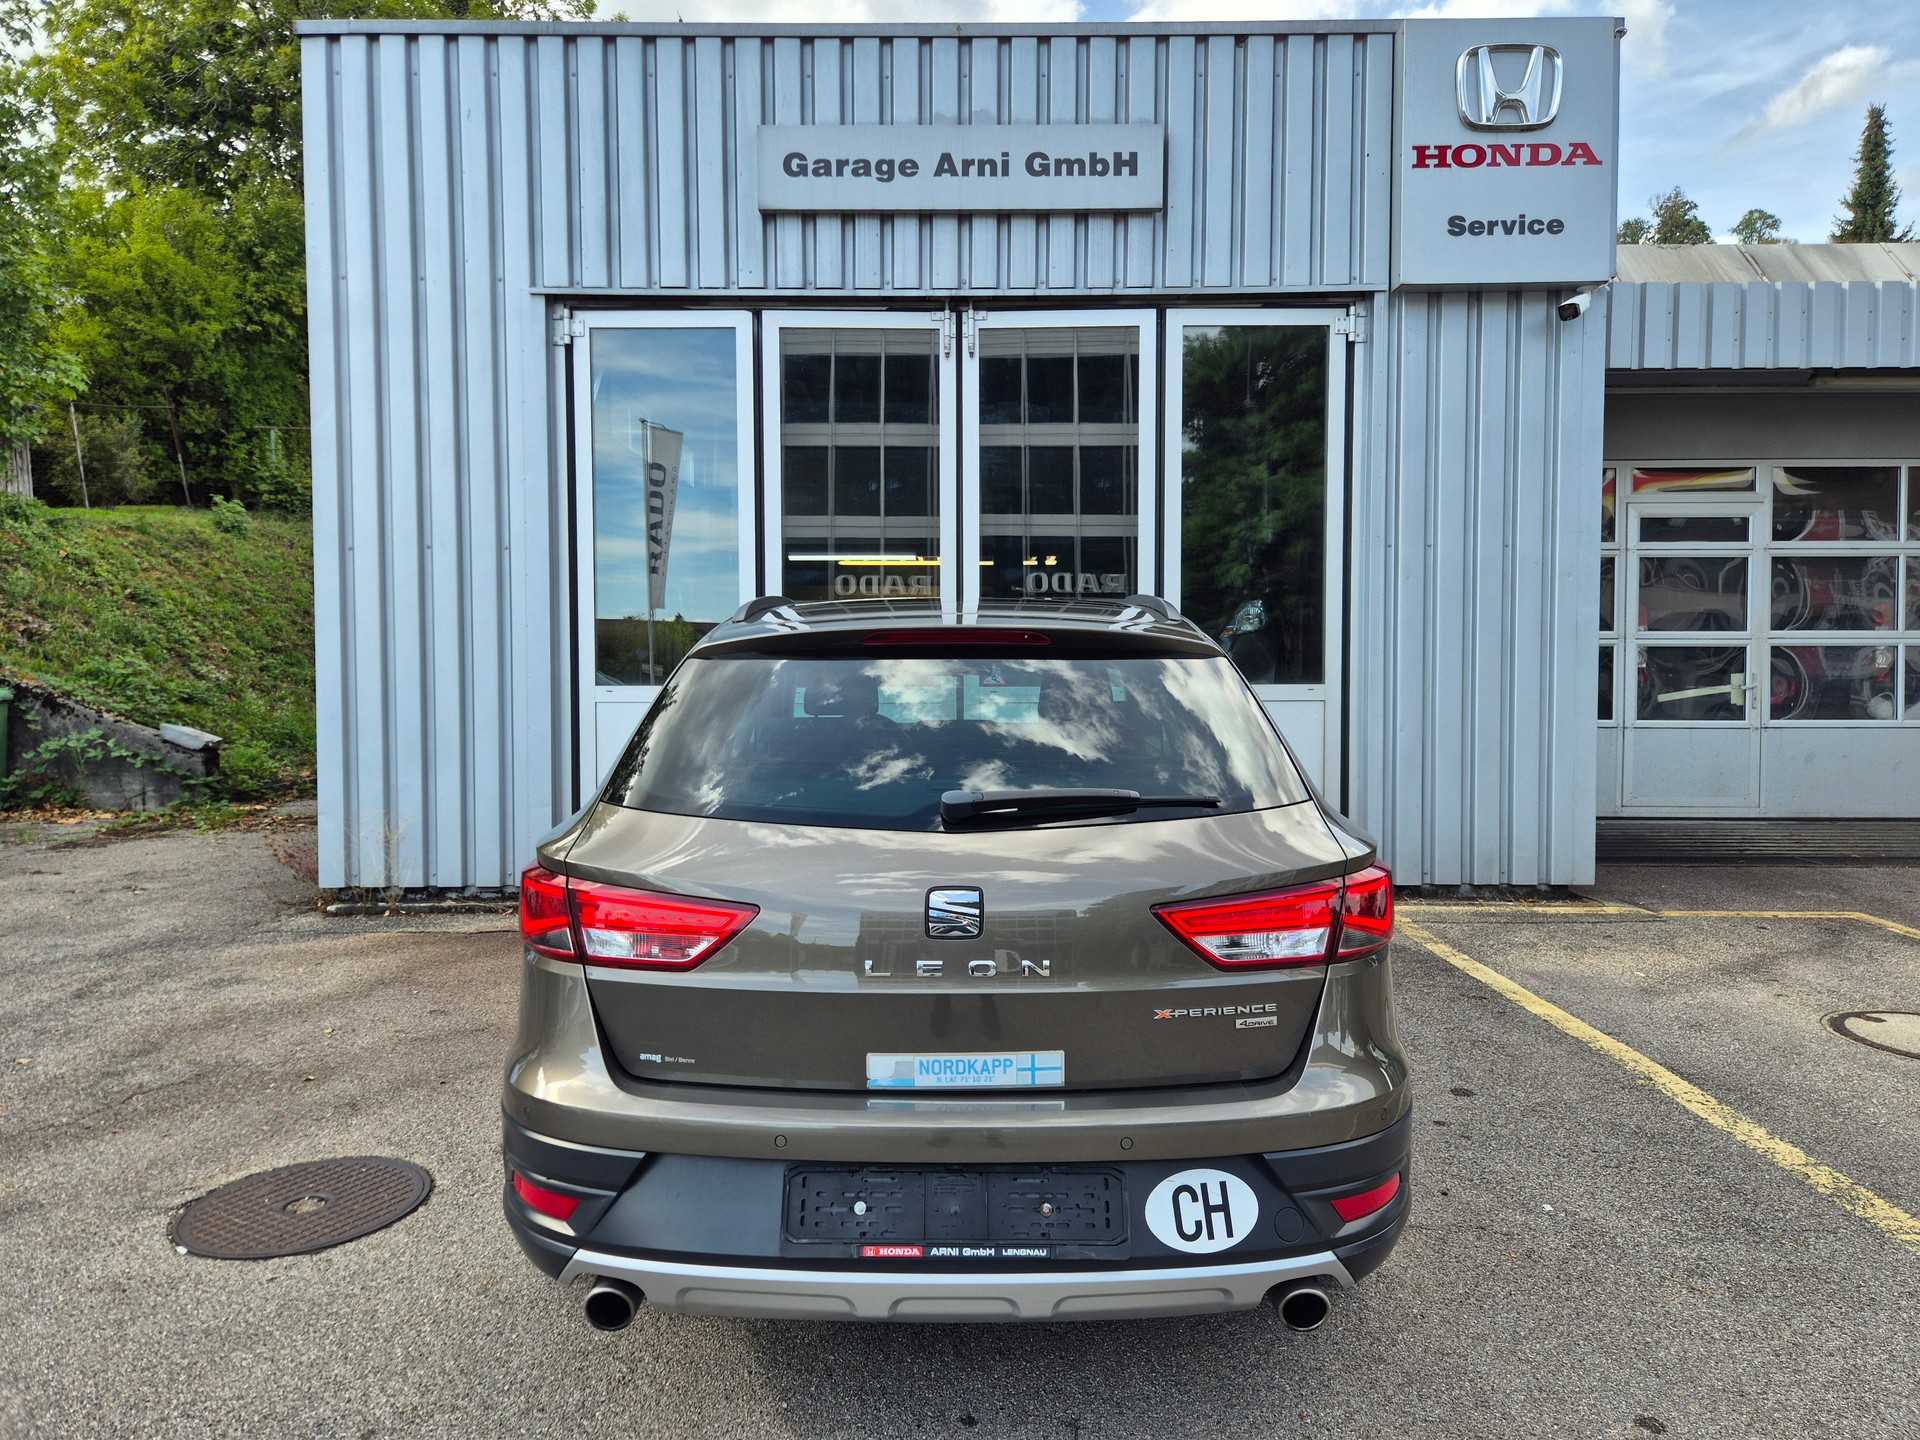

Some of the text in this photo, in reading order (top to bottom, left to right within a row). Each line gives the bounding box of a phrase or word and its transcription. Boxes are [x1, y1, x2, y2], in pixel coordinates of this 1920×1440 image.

[1412, 143, 1603, 168] HONDA
[782, 151, 1139, 183] Garage Arni GmbH
[1447, 214, 1565, 237] Service
[649, 462, 668, 575] RADO
[864, 959, 1051, 977] LEON
[1239, 1019, 1275, 1027] 4DRIVE
[640, 1053, 662, 1063] amag
[918, 1058, 1013, 1076] NORDKAPP
[1172, 1180, 1234, 1242] CH
[879, 1247, 1047, 1257] HONDA ARNI GmbH LENGNAU
